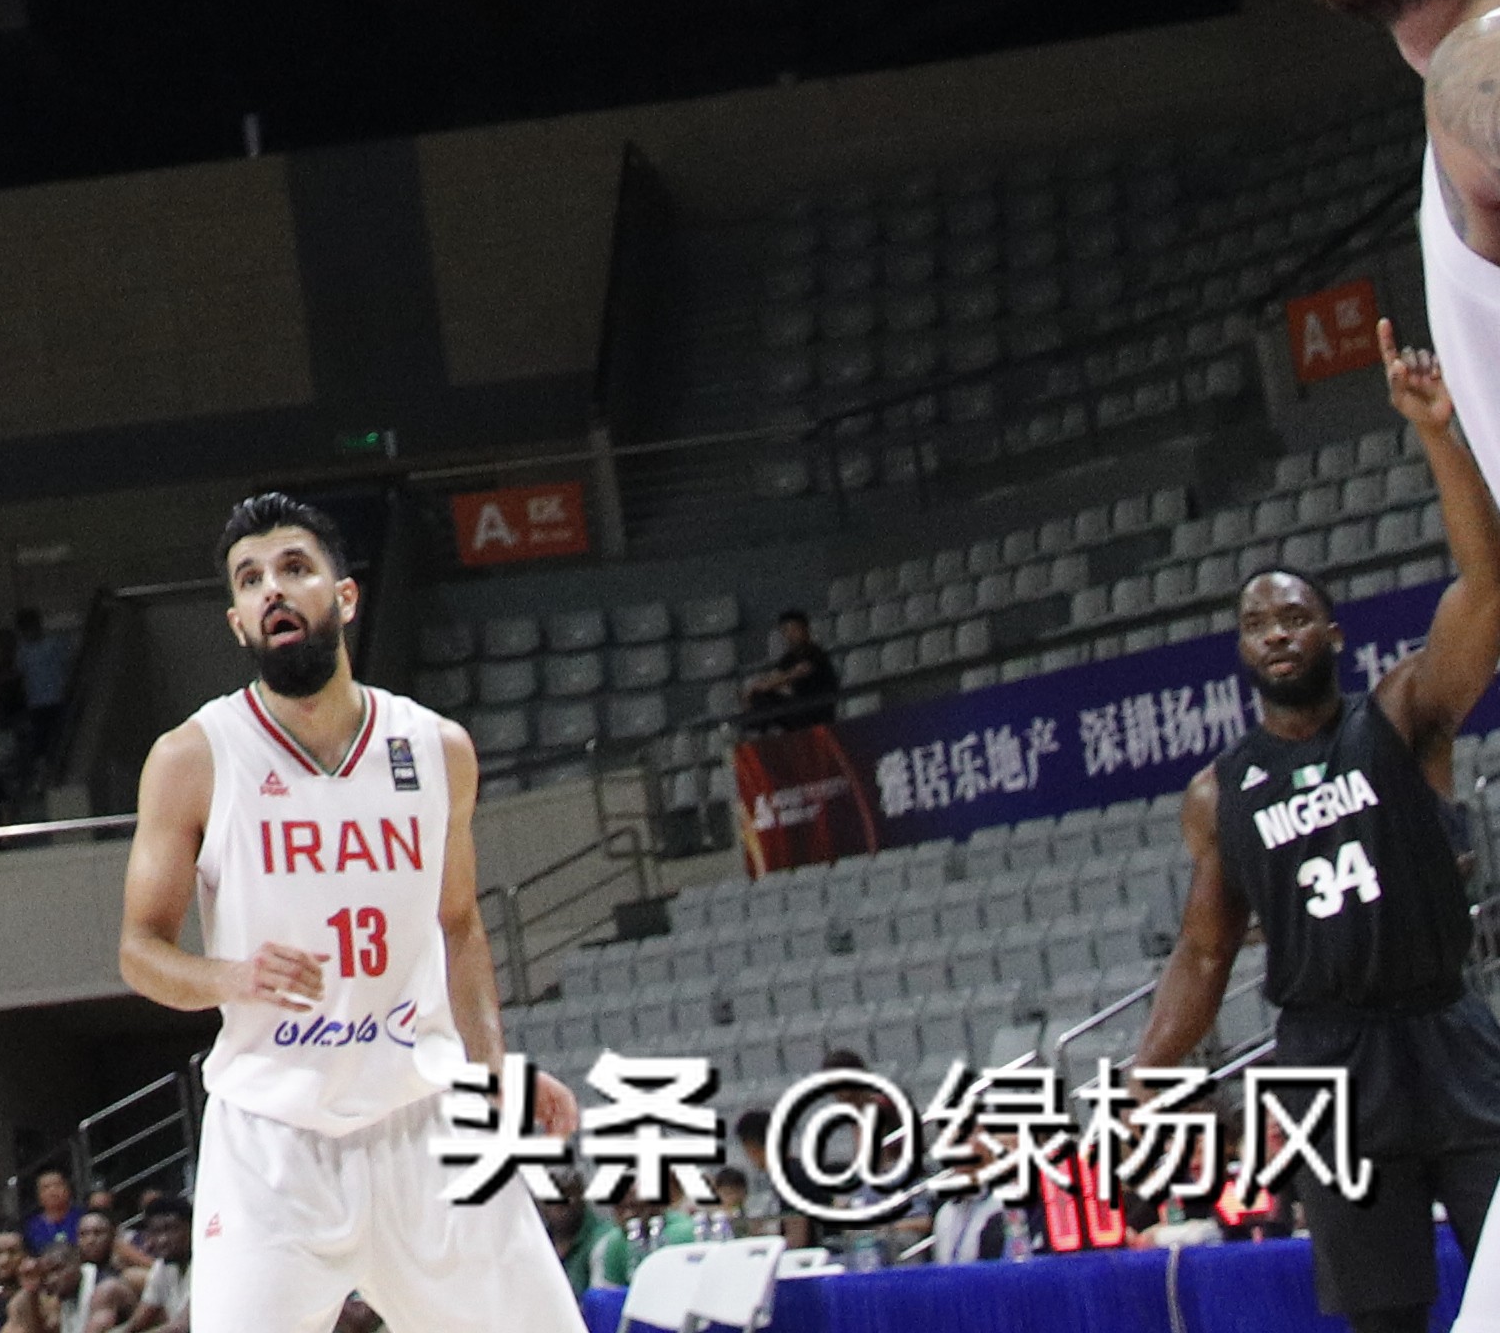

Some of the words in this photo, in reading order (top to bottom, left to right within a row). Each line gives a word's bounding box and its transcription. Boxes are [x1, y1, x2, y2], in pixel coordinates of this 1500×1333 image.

[875, 714, 1061, 819] 雅居乐地产
[260, 817, 424, 874] IRAN
[1253, 769, 1379, 849] NIGERIA
[1297, 840, 1381, 919] 34
[327, 907, 388, 978] 13
